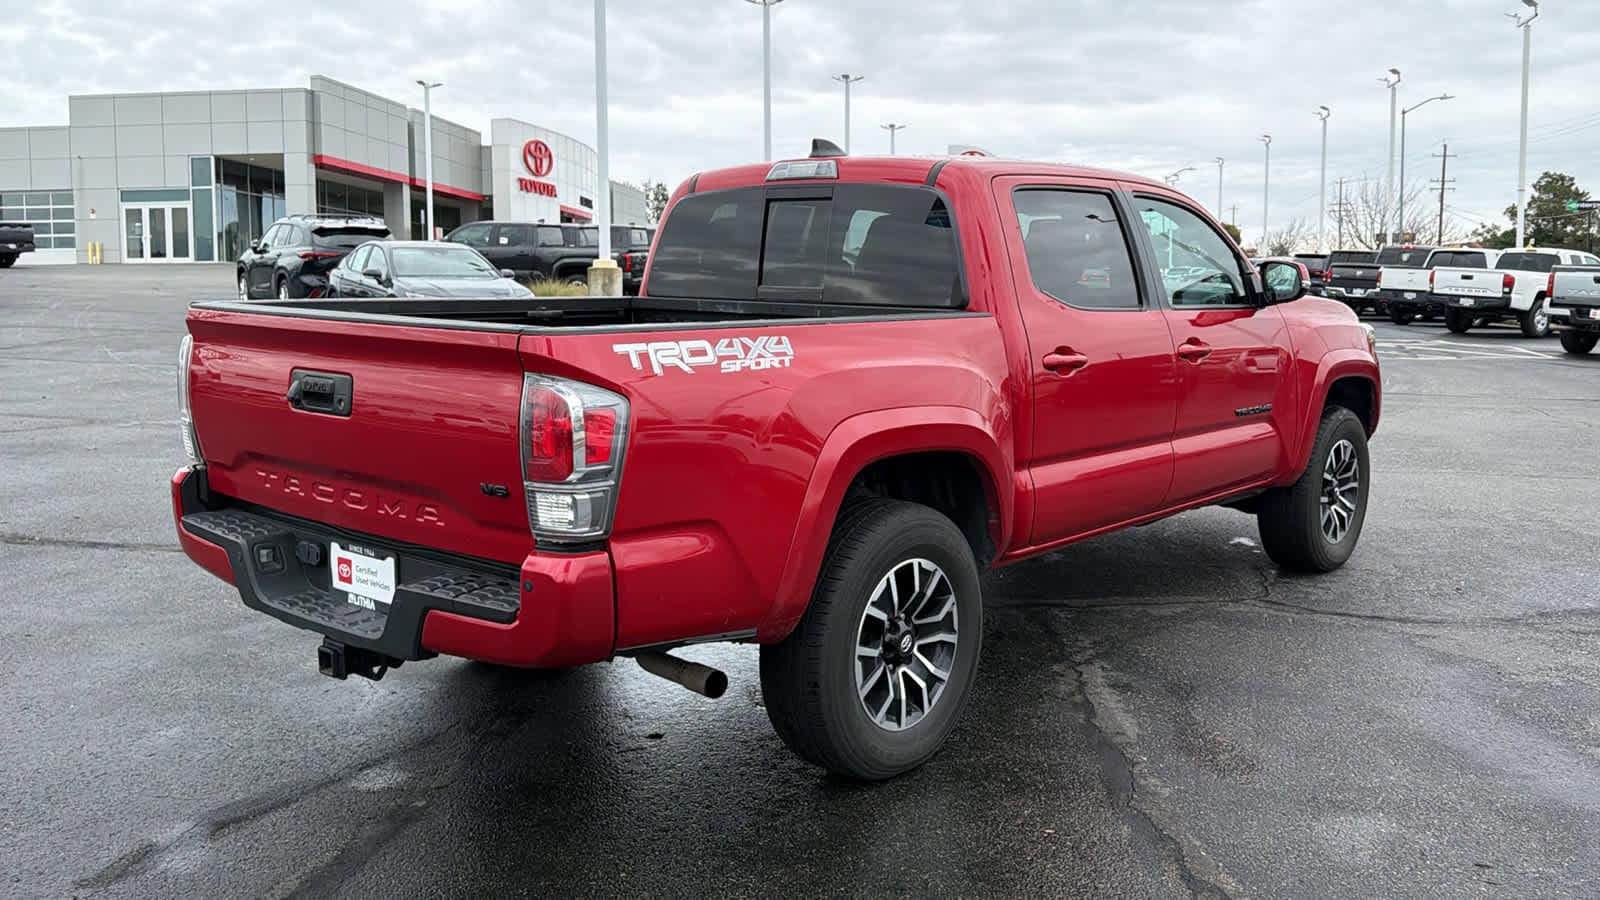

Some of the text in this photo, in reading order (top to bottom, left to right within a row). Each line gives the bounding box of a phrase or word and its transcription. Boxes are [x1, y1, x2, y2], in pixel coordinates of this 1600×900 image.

[517, 177, 557, 198] TOYOTA
[613, 340, 718, 376] TRD
[720, 356, 795, 374] SPORT
[256, 469, 446, 527] TACOMA
[479, 482, 510, 498] V6
[355, 565, 378, 577] Certified
[355, 576, 390, 592] Used Vehicles
